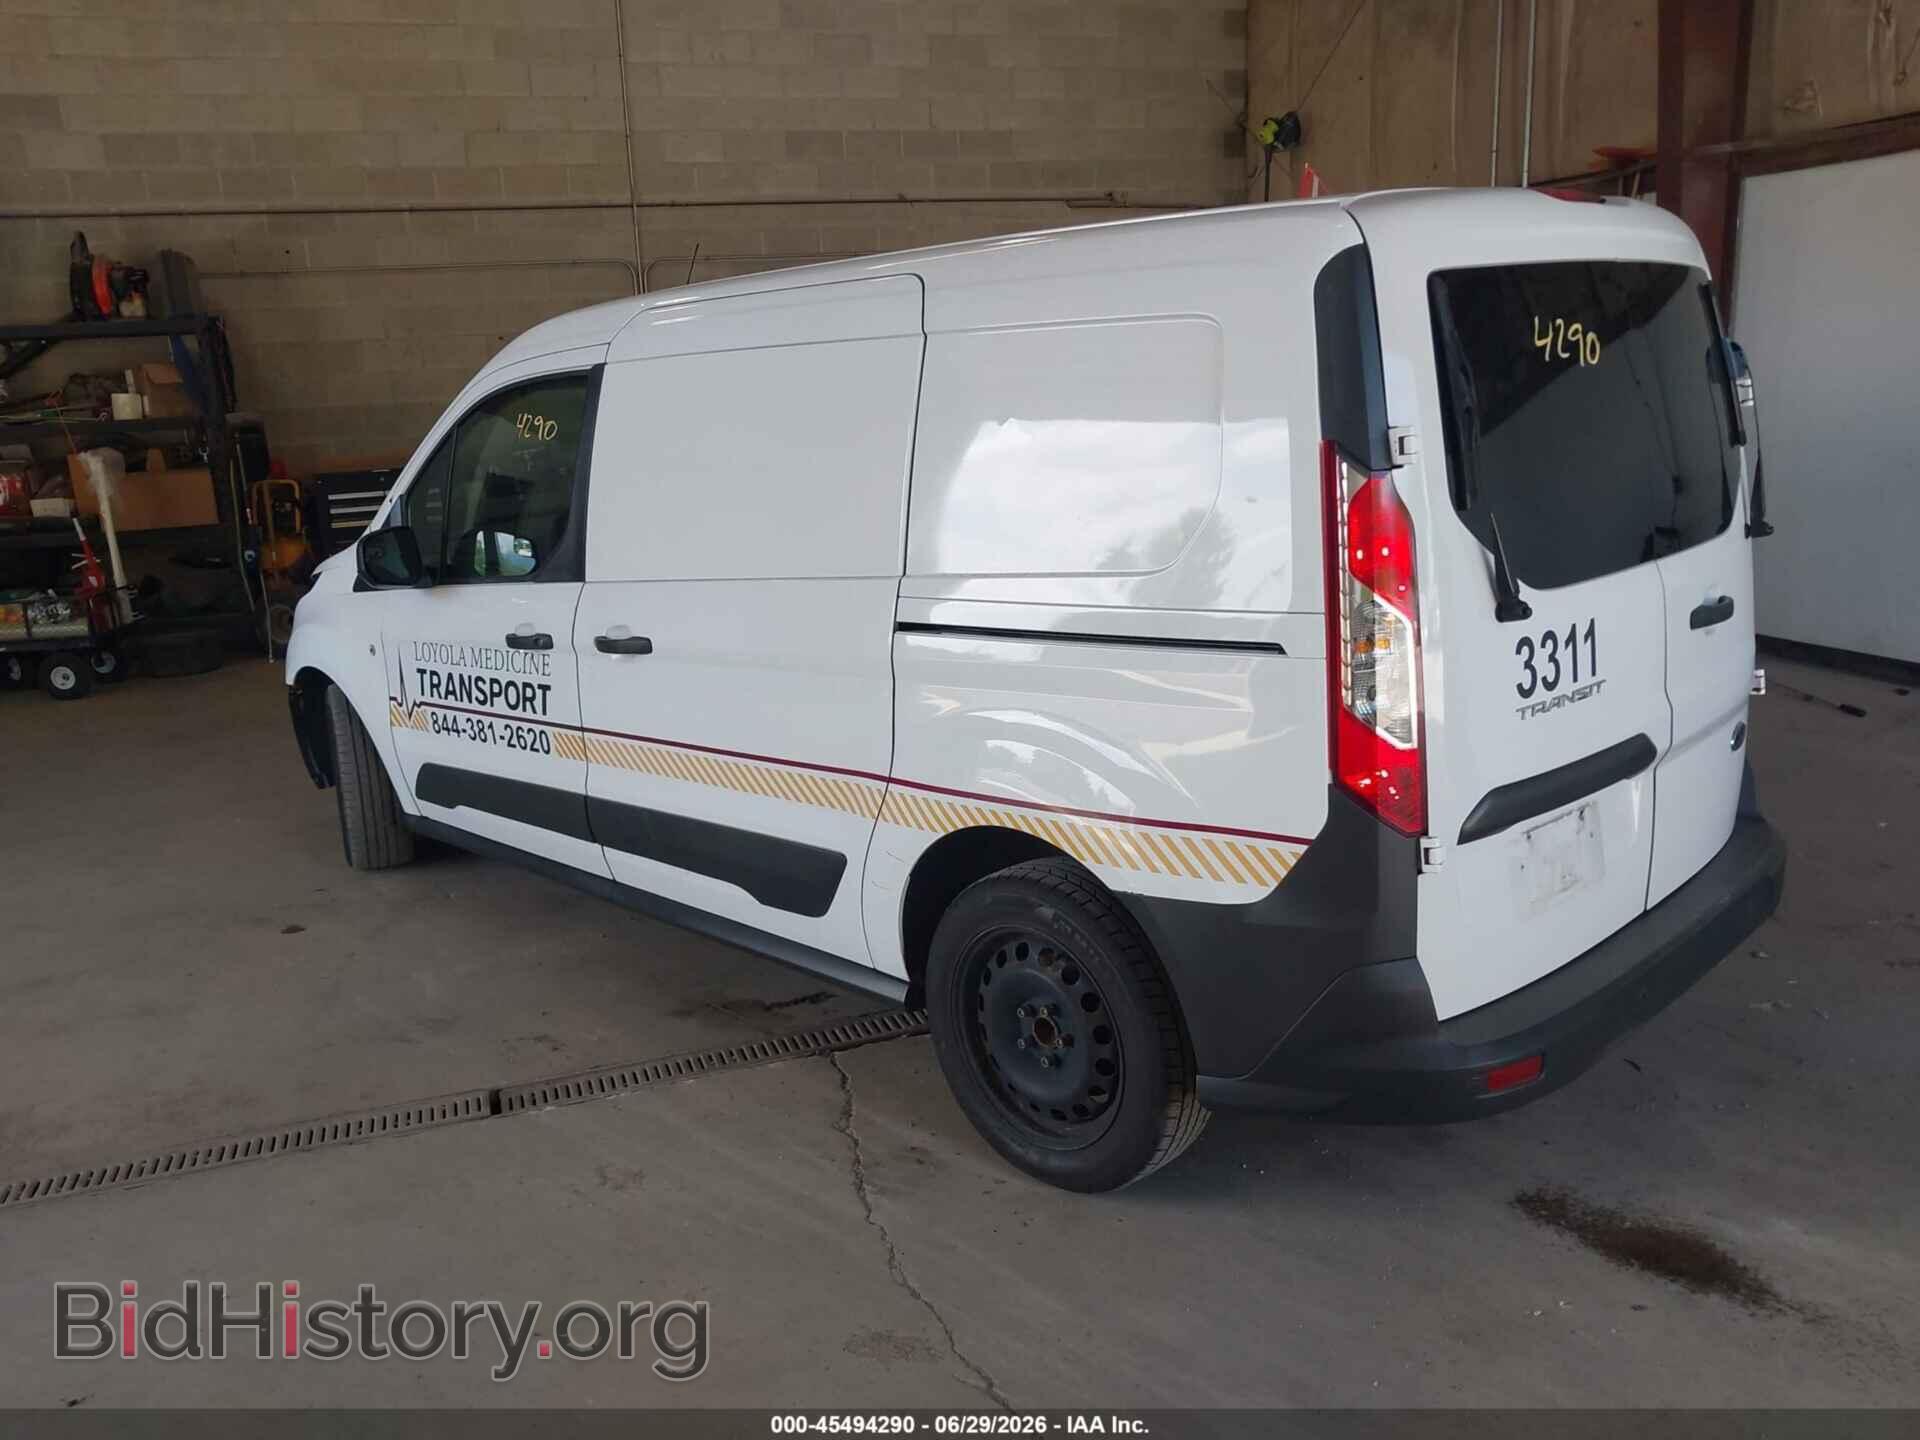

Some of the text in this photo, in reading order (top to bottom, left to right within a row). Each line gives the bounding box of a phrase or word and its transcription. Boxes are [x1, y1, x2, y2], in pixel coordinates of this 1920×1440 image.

[1534, 315, 1600, 367] 4290
[516, 412, 558, 441] 4290
[413, 641, 552, 676] LOYOLA MEDICINE
[1515, 617, 1597, 699] 3311
[416, 668, 552, 716] TRANSPORT
[1515, 679, 1607, 721] TRANSIT
[430, 711, 551, 755] 844-381-2620
